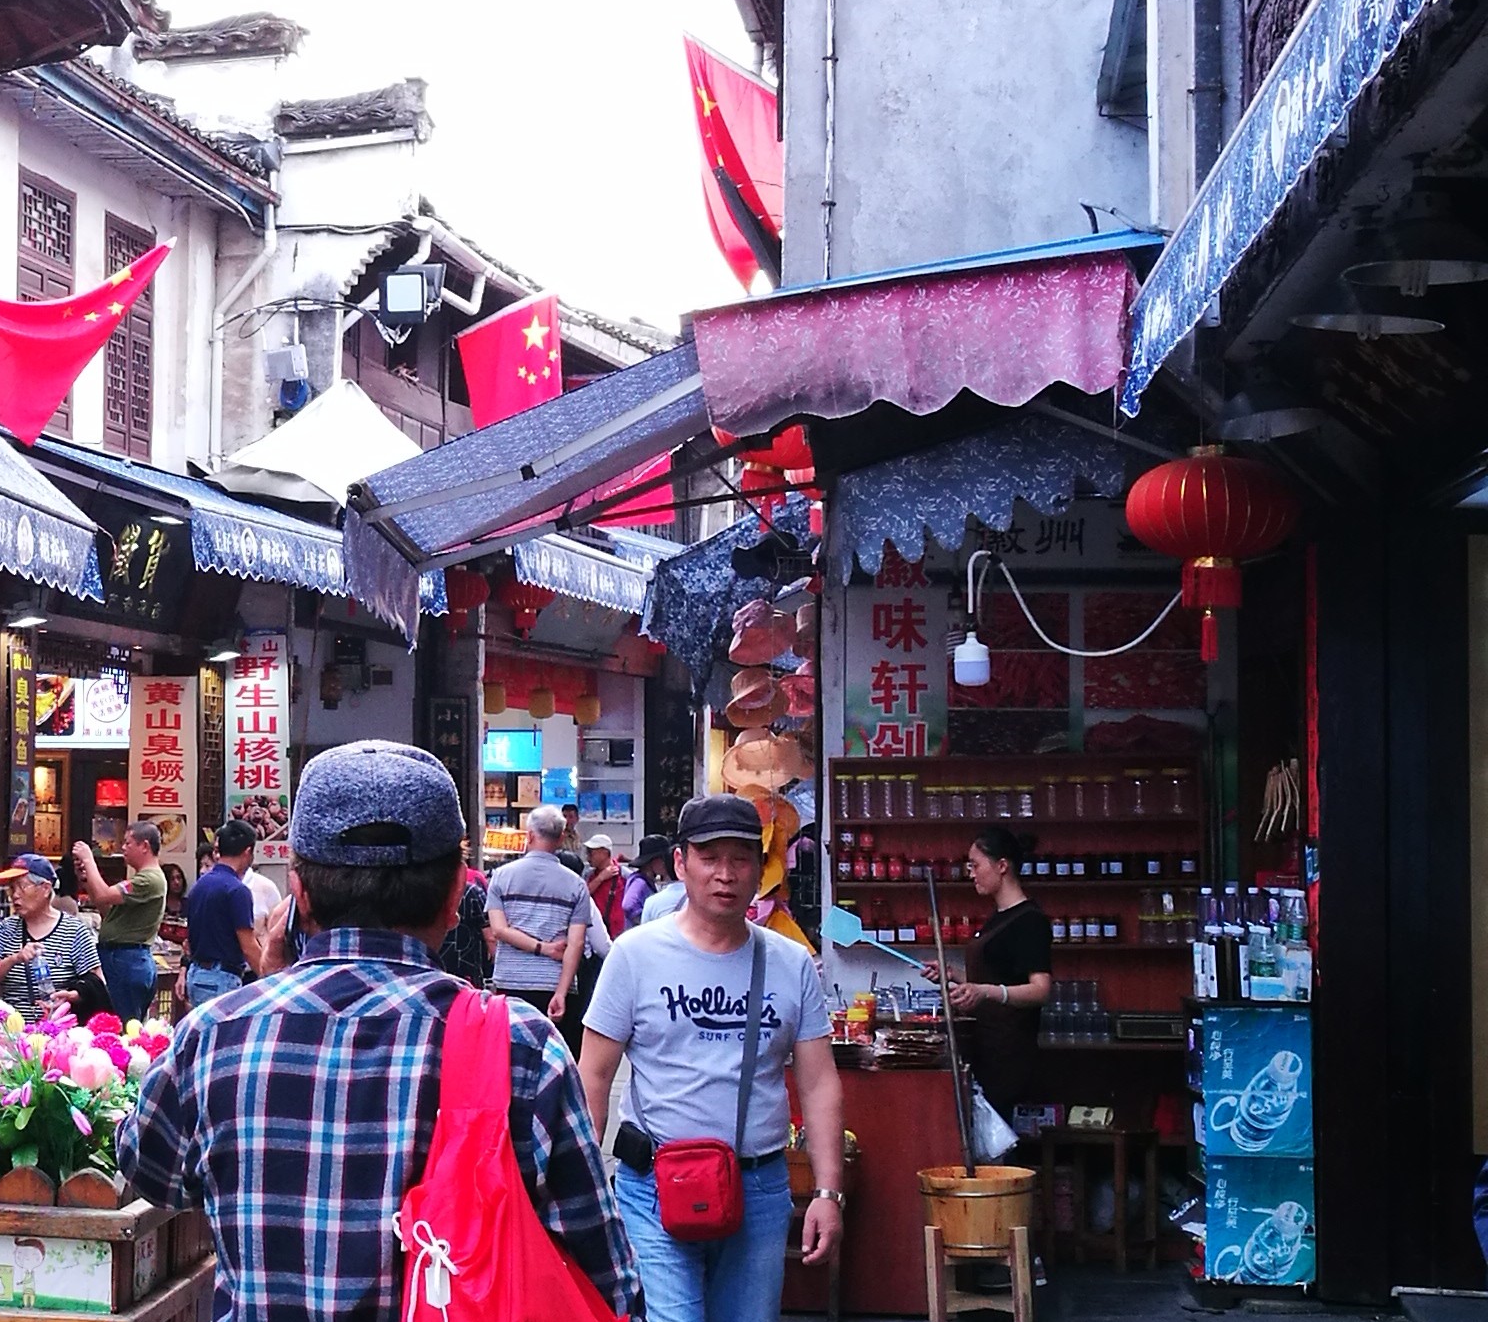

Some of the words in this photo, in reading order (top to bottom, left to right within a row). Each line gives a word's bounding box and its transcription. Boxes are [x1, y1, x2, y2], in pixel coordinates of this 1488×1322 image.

[141, 681, 185, 808] 黄山臭鳜鱼
[233, 656, 282, 790] 野生山核桃
[660, 984, 782, 1026] Hollistr
[699, 1030, 730, 1042] SURF
